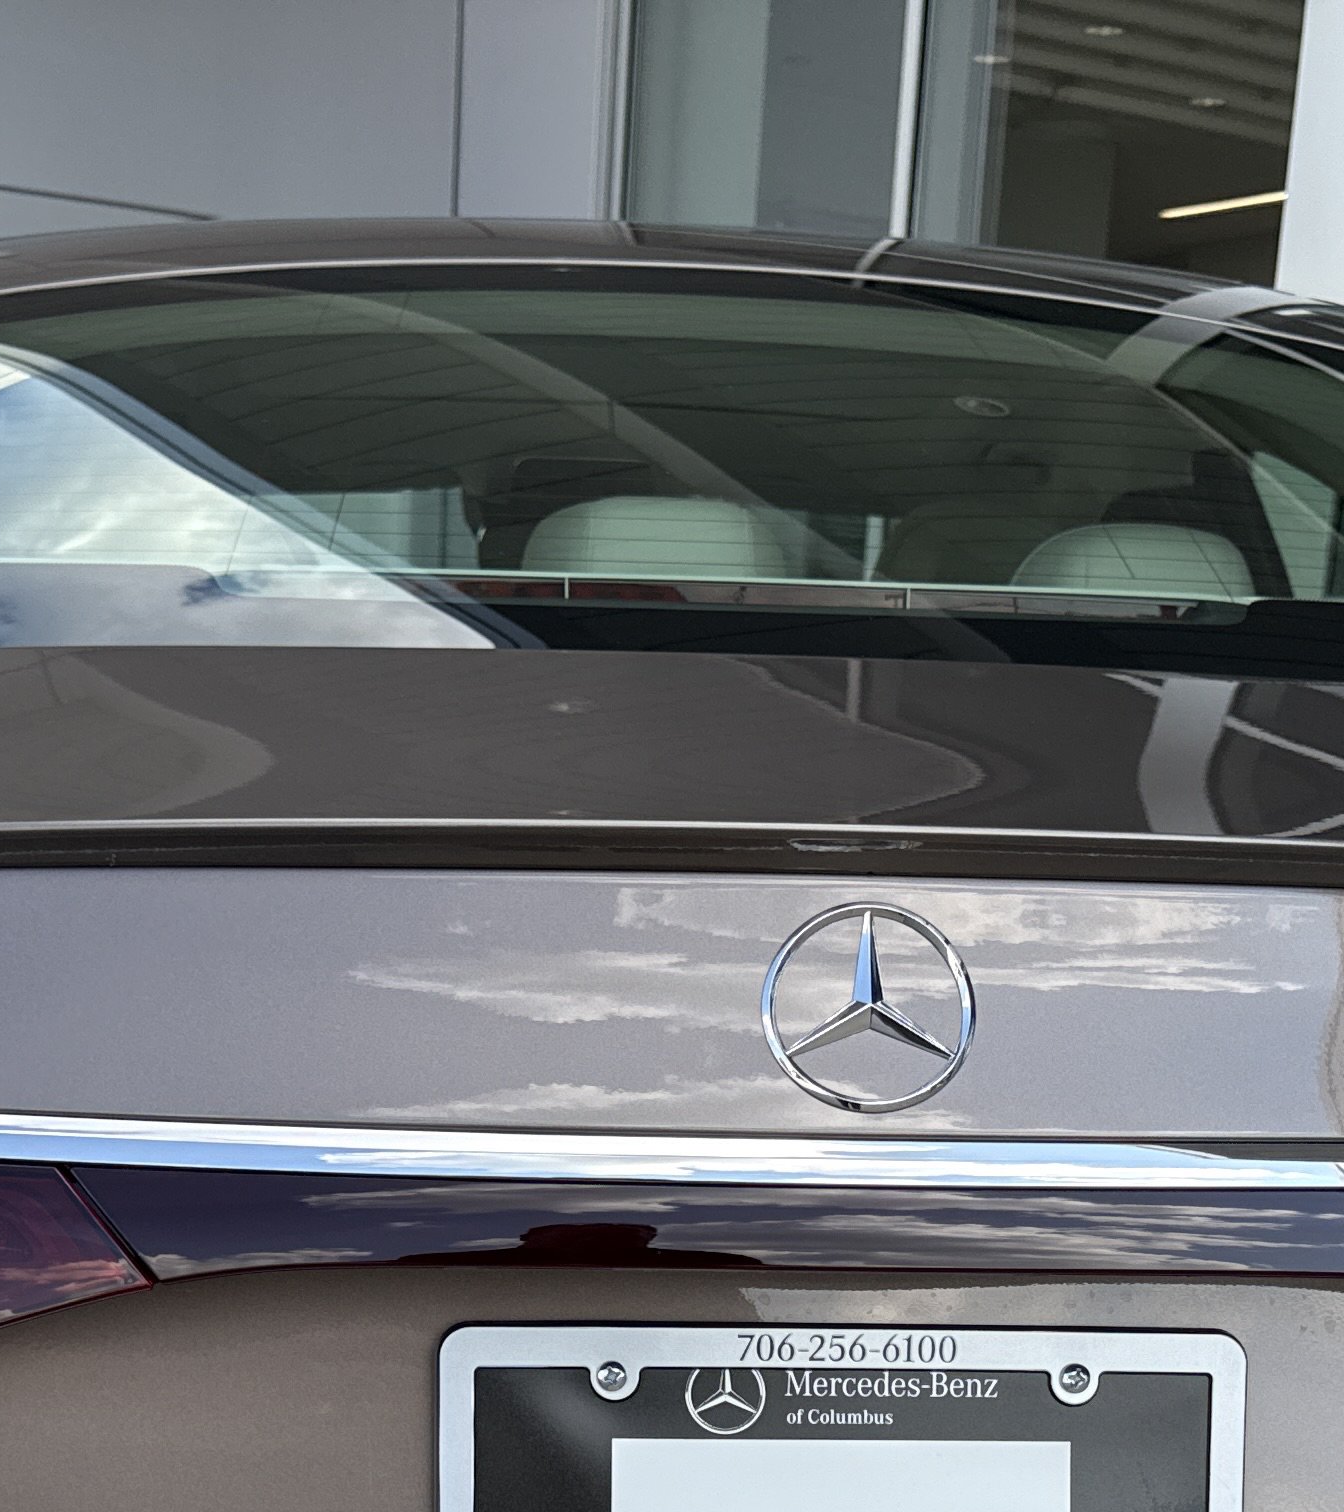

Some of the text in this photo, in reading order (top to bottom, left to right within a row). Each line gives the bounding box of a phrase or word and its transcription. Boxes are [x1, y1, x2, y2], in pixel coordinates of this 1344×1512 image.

[737, 1333, 958, 1364] 706-256-6100
[785, 1370, 999, 1398] Mercedes-Benz
[786, 1409, 894, 1426] of Columbus
